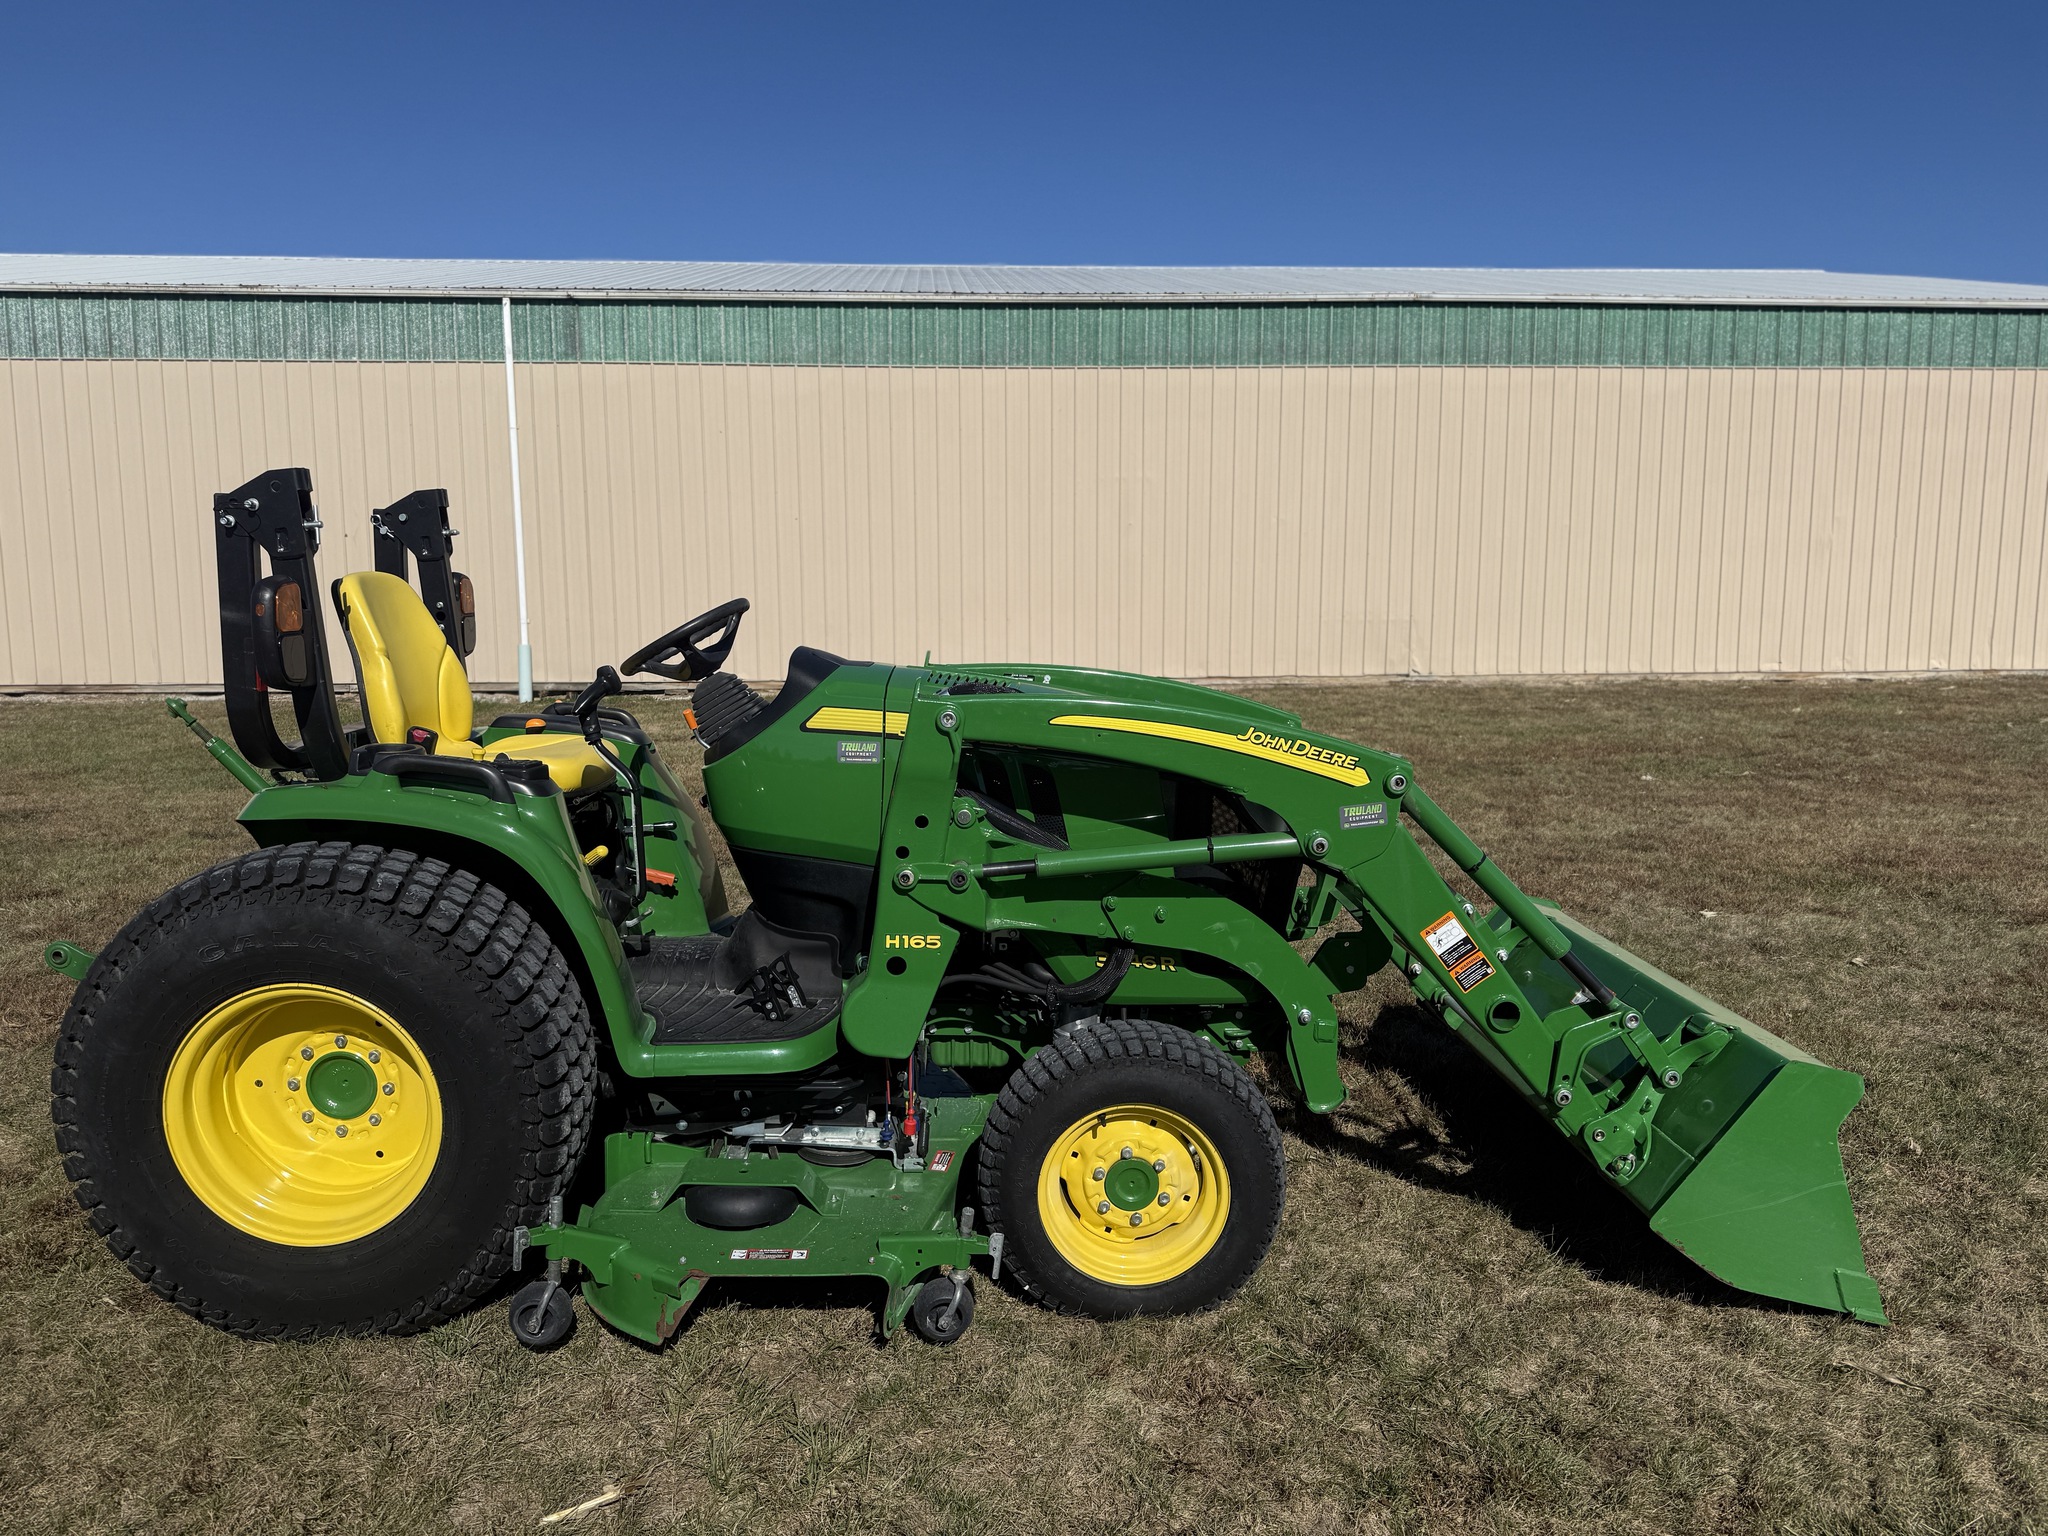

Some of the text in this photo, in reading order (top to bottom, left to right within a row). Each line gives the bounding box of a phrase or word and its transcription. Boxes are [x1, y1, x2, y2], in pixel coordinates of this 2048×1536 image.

[841, 742, 877, 752] TRULAND
[1236, 727, 1359, 769] JOHN DEERE
[1343, 803, 1383, 817] TRULAND
[1430, 915, 1451, 932] WARNING
[885, 934, 942, 949] H165
[197, 931, 413, 979] GALAXY
[1095, 951, 1178, 972] 346R
[1459, 955, 1481, 971] WARNING
